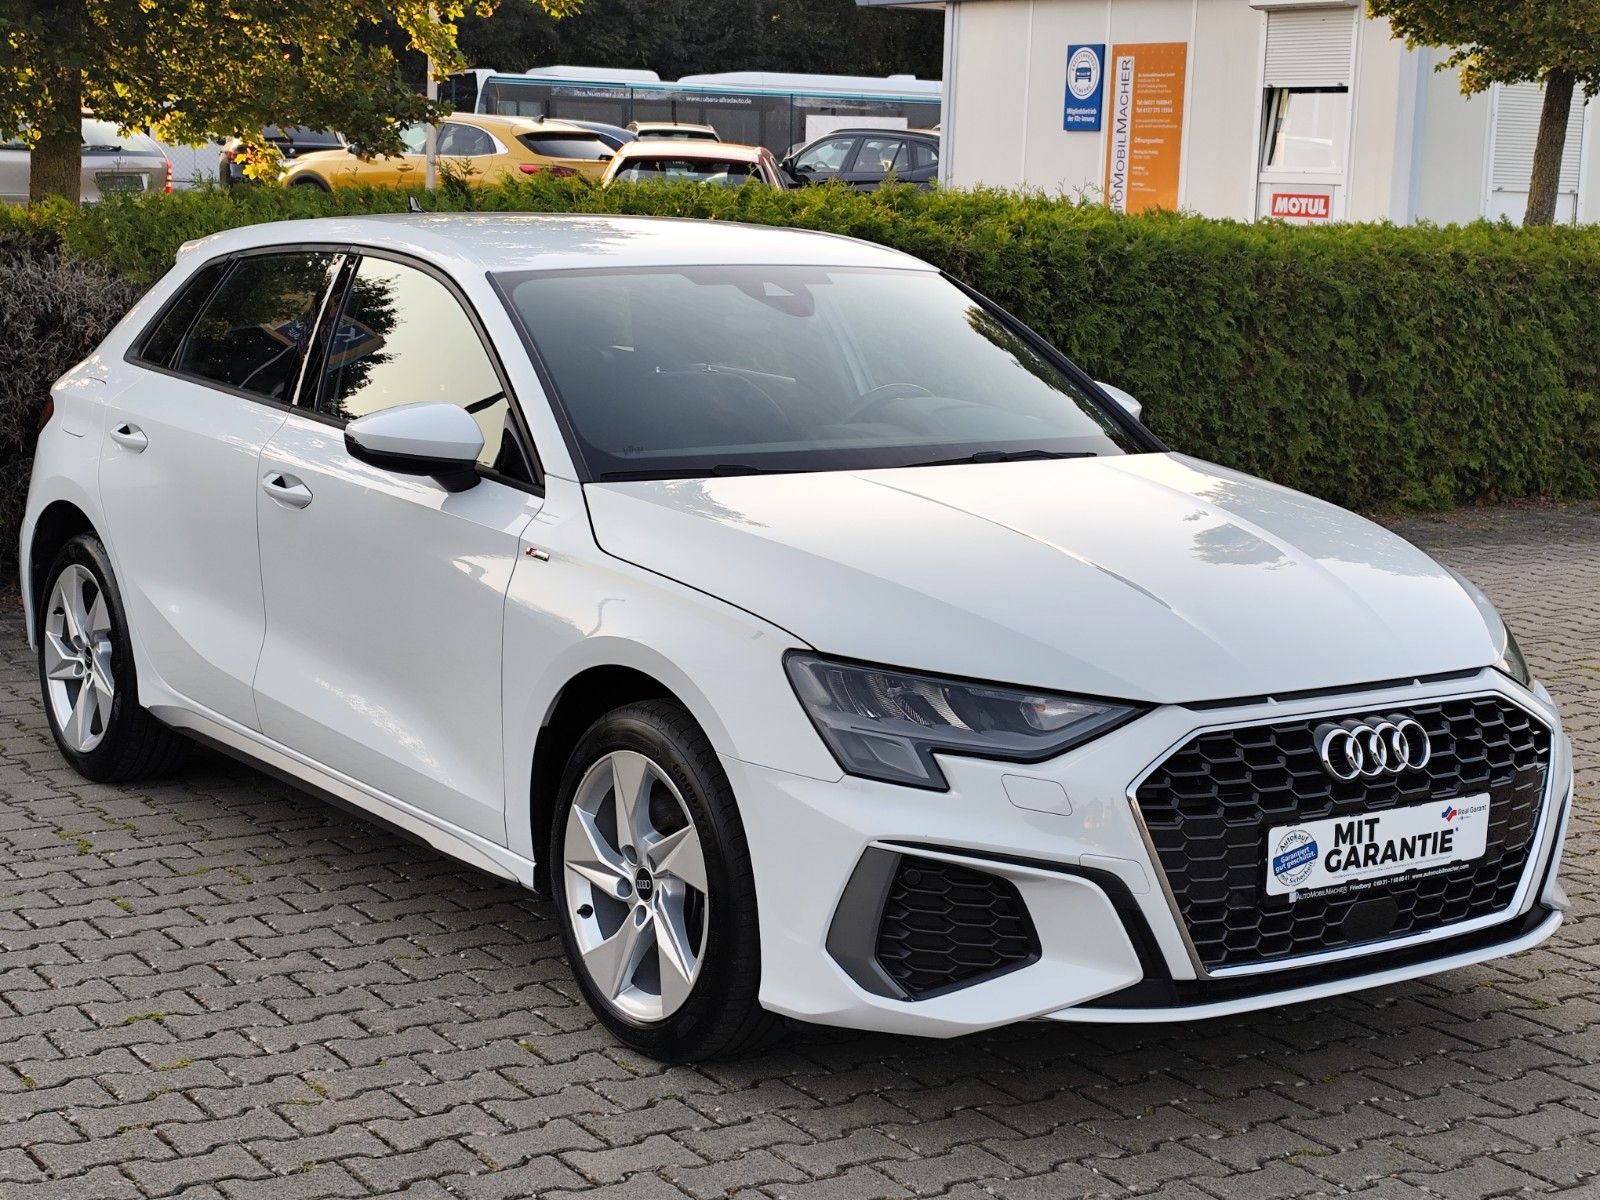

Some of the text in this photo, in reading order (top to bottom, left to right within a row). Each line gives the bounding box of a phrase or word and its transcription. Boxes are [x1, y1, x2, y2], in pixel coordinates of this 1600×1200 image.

[1274, 196, 1327, 215] MOTUL
[1458, 804, 1487, 816] Real Garant
[1280, 832, 1309, 852] Autokauf
[1334, 818, 1380, 848] MIT
[1280, 846, 1311, 864] Garantiert
[1324, 828, 1454, 873] GARANTIE
[1275, 863, 1287, 874] gut
[1349, 882, 1372, 892] Friedberg
